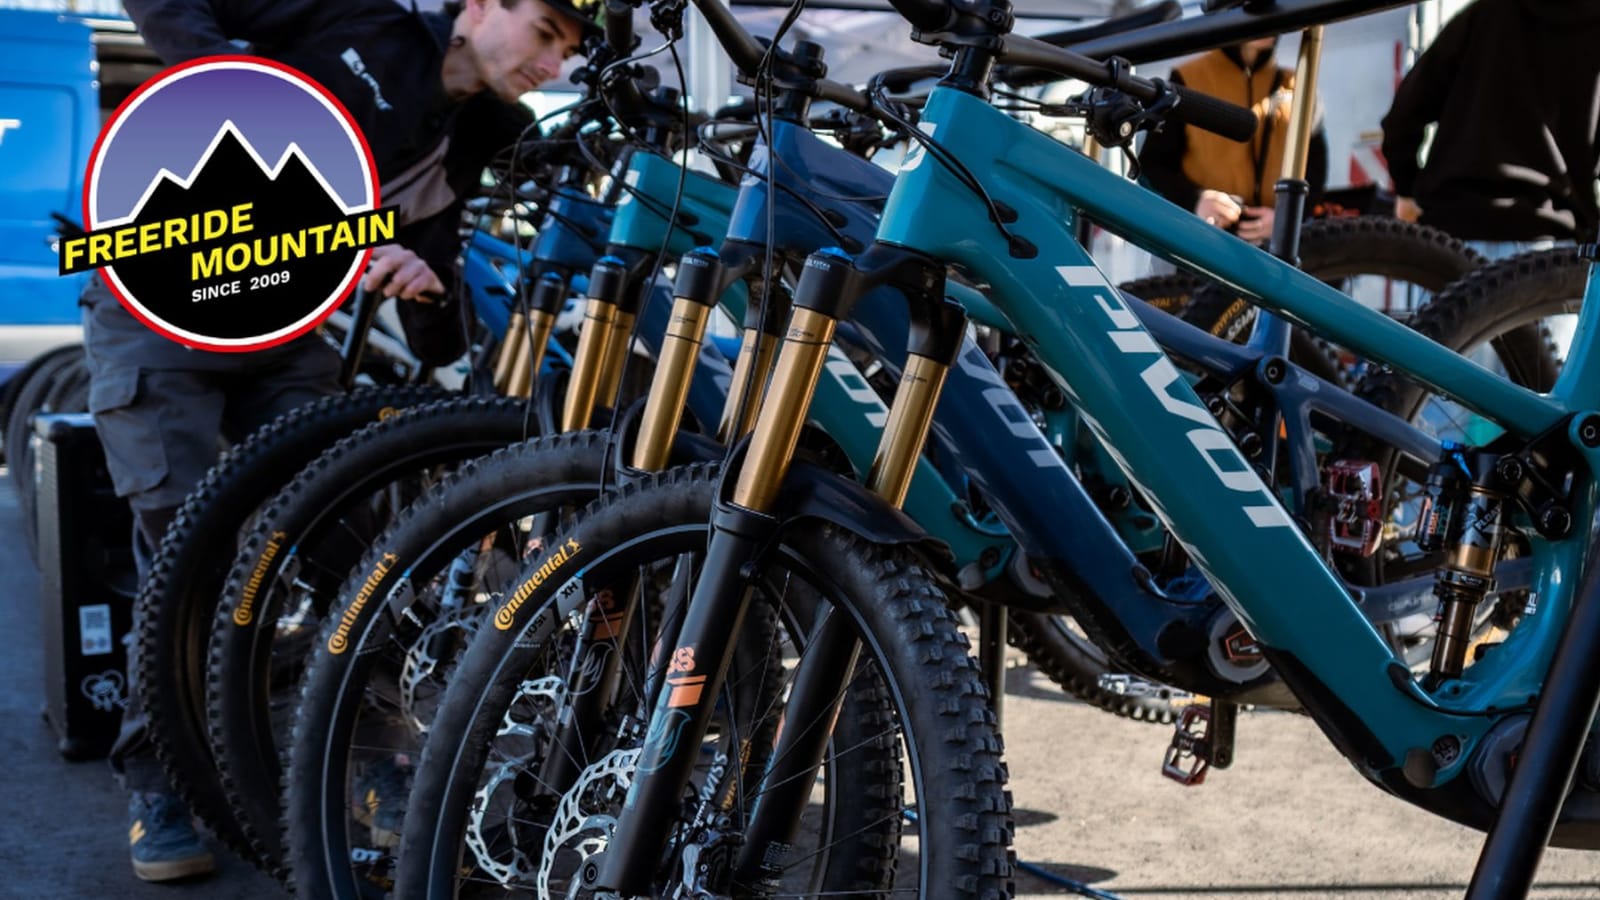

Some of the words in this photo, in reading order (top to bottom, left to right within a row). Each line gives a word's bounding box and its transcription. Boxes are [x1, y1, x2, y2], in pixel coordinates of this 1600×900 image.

[1054, 265, 1290, 528] PIVOT
[233, 539, 281, 626] Continental
[327, 560, 389, 655] Continental
[494, 544, 570, 631] Continental
